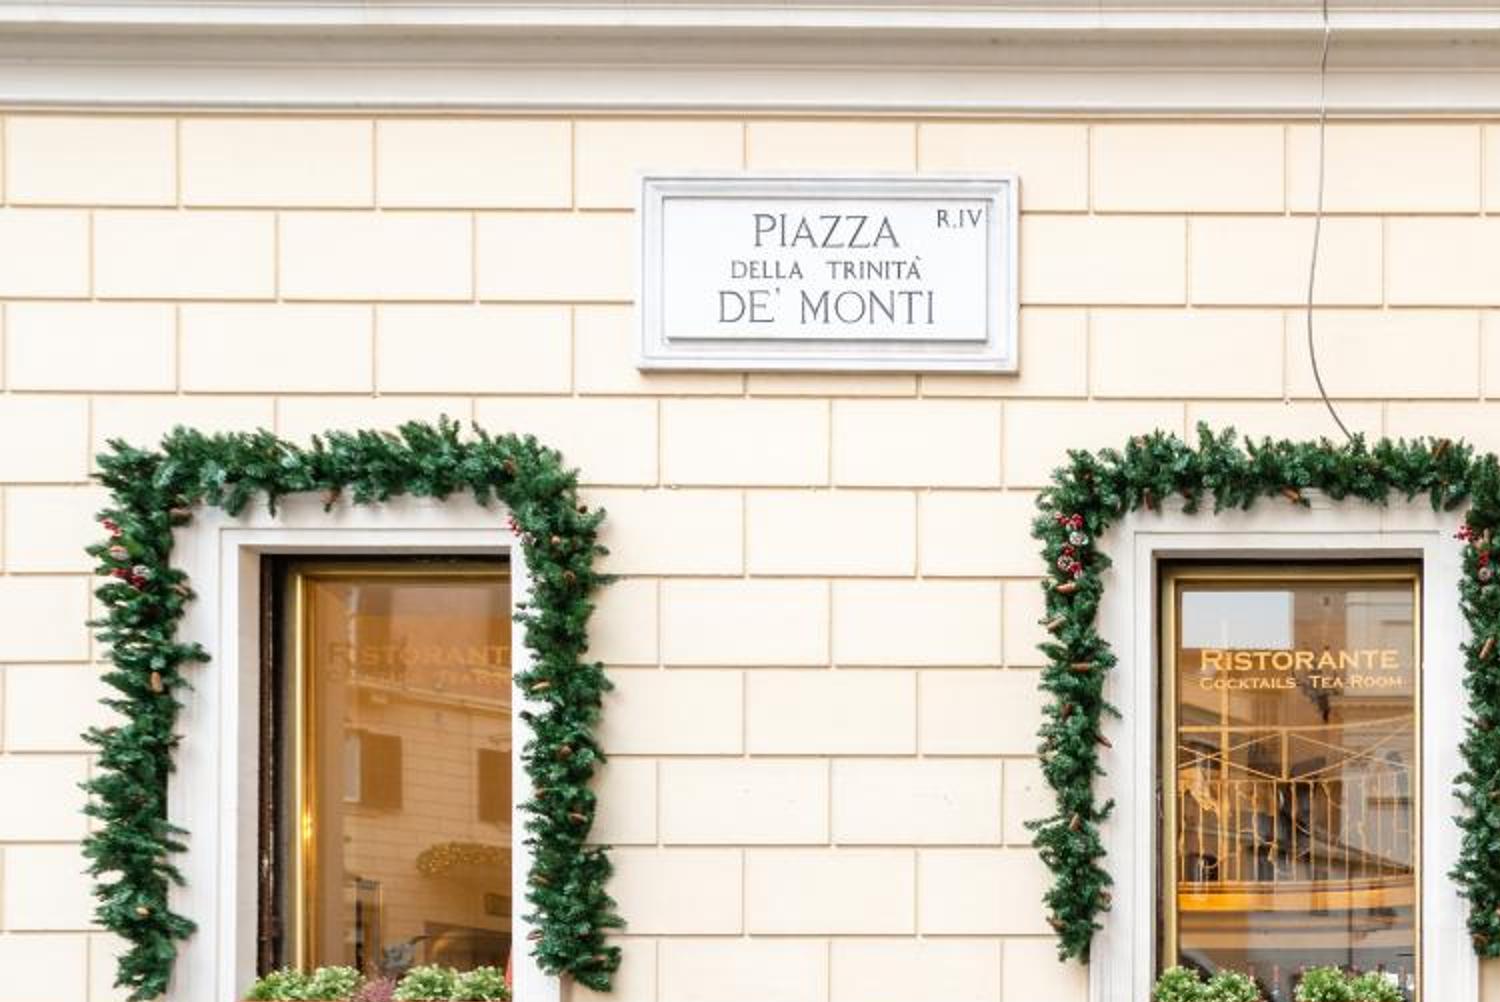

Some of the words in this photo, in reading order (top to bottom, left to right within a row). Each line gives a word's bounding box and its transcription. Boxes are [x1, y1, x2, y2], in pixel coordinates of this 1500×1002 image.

[936, 208, 983, 229] R.IV
[753, 213, 900, 249] PIAZZA
[731, 259, 804, 280] DELLA
[825, 255, 923, 280] TRINITÀ
[799, 290, 935, 325] MONTI
[1199, 649, 1399, 671] RISTORANTE
[1199, 676, 1296, 689] COCKTAILS
[1307, 675, 1344, 689] TEA
[1350, 673, 1404, 689] ROOM
